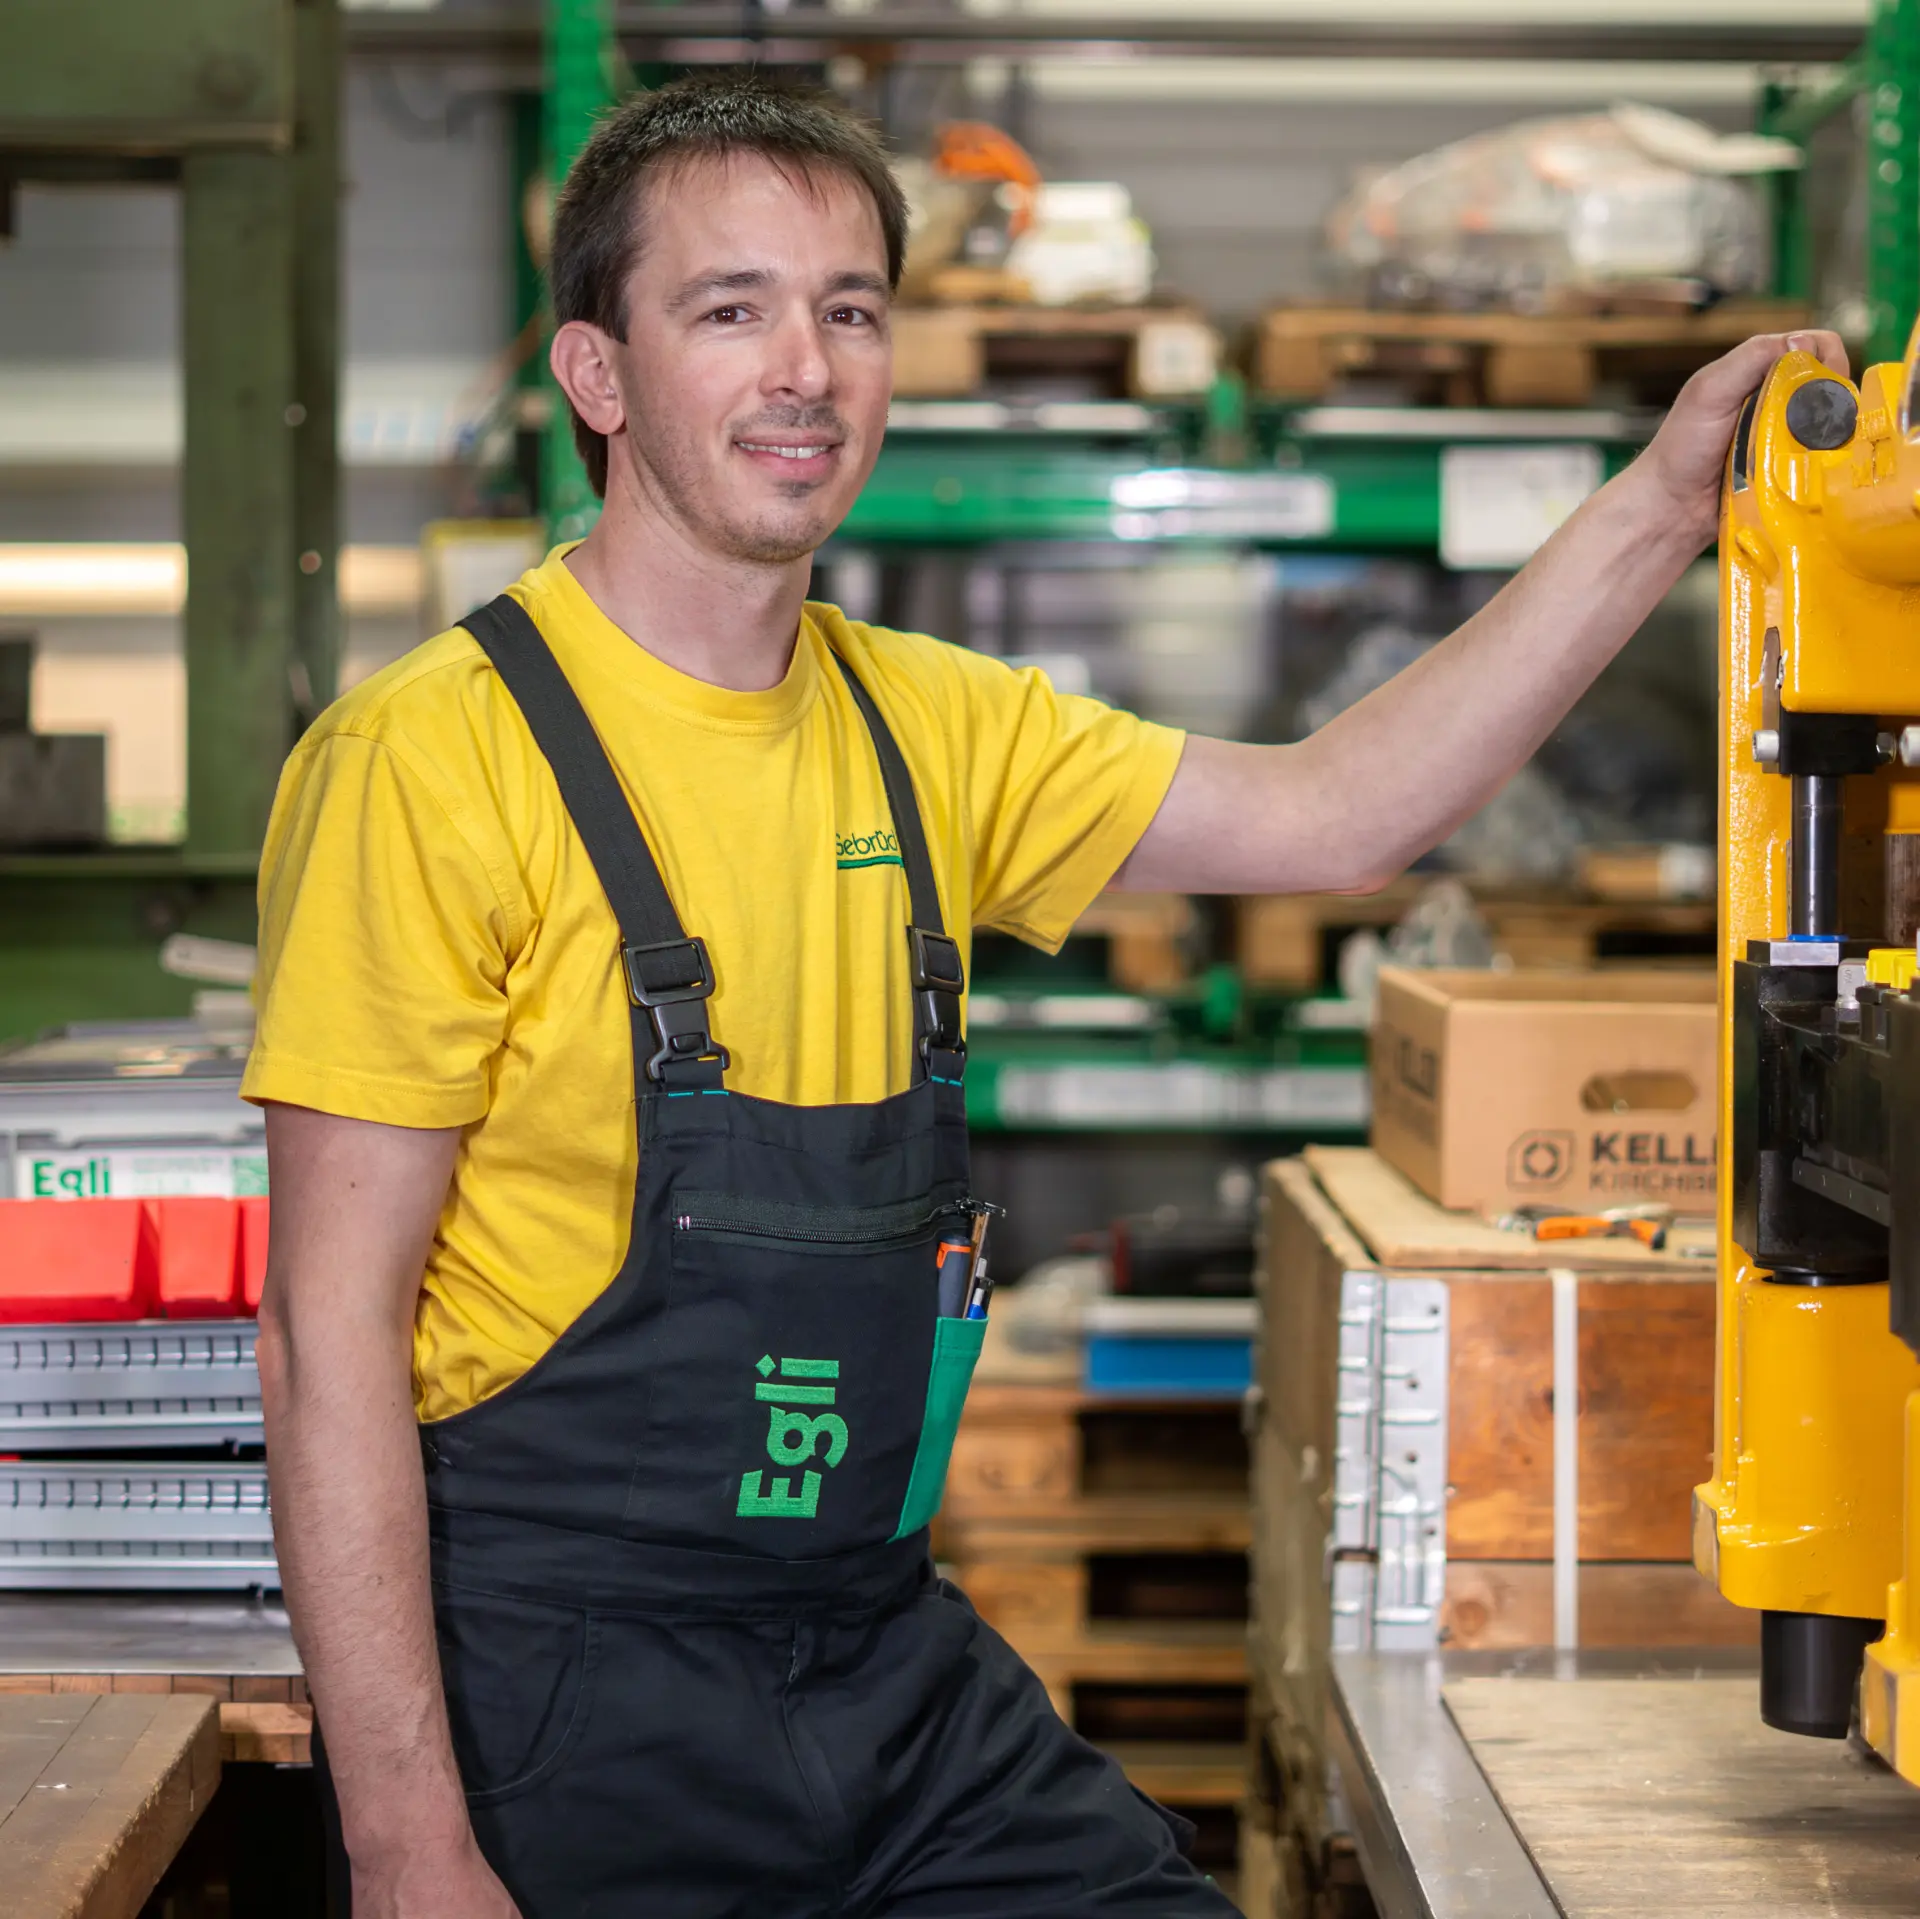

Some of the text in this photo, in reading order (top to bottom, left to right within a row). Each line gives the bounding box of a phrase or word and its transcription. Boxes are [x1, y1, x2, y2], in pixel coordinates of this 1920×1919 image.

[1591, 1132, 1717, 1166] KELL
[32, 1157, 110, 1197] Egli
[736, 1354, 849, 1518] Egli
